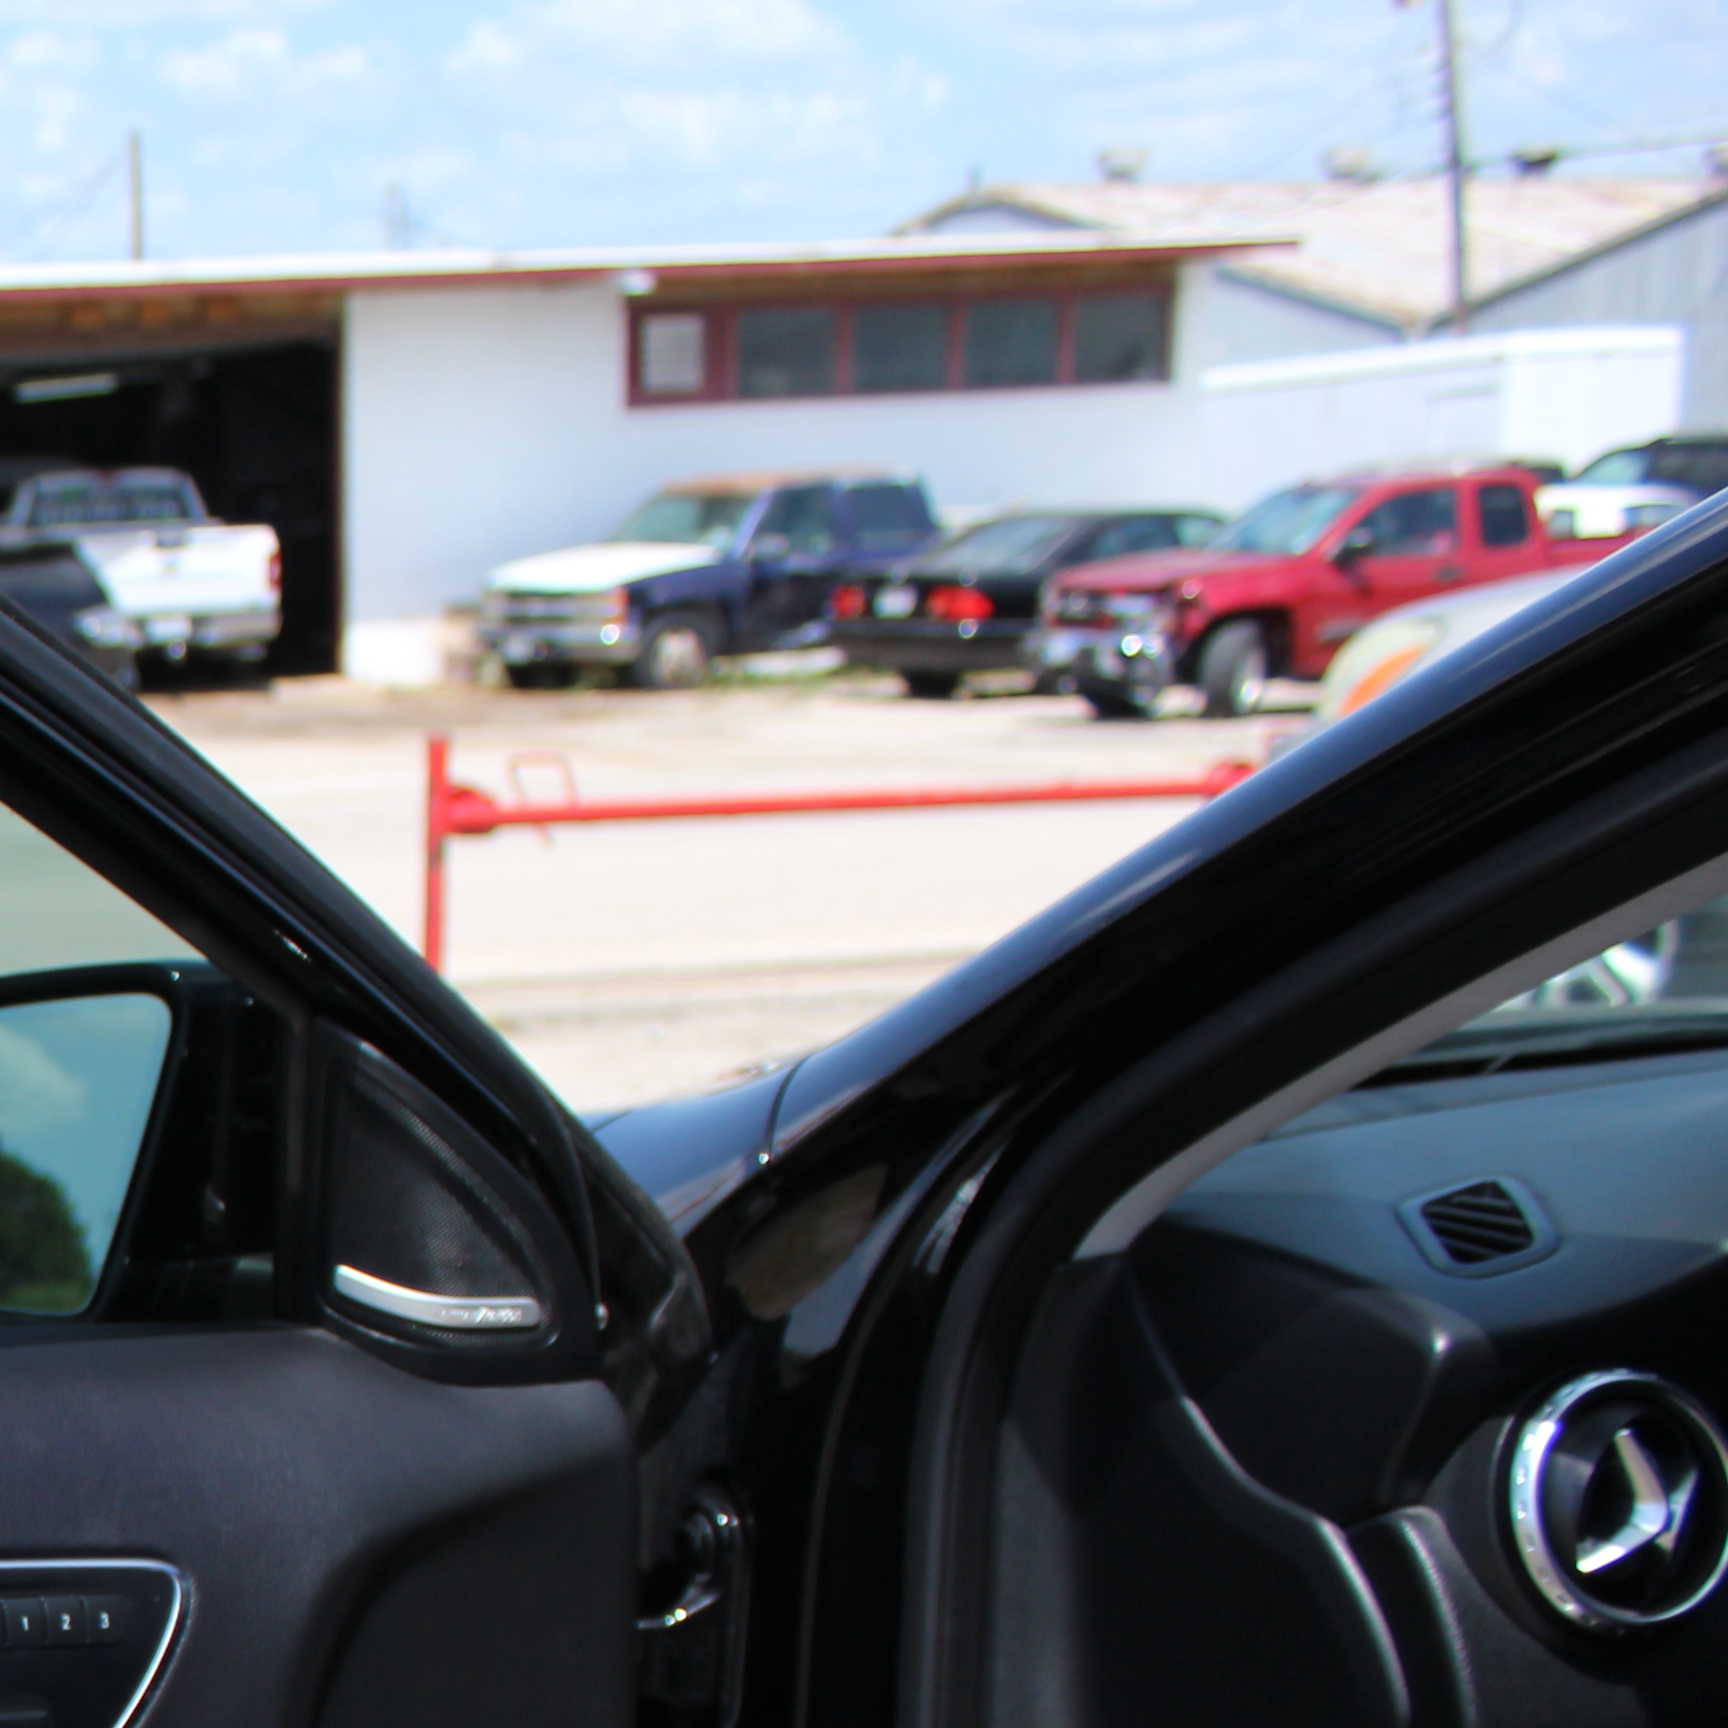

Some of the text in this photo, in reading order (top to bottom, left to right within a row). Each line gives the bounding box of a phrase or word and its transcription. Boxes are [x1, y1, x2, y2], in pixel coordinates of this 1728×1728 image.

[21, 1615, 30, 1632] 1
[60, 1613, 72, 1631] 2
[99, 1611, 111, 1629] 3
